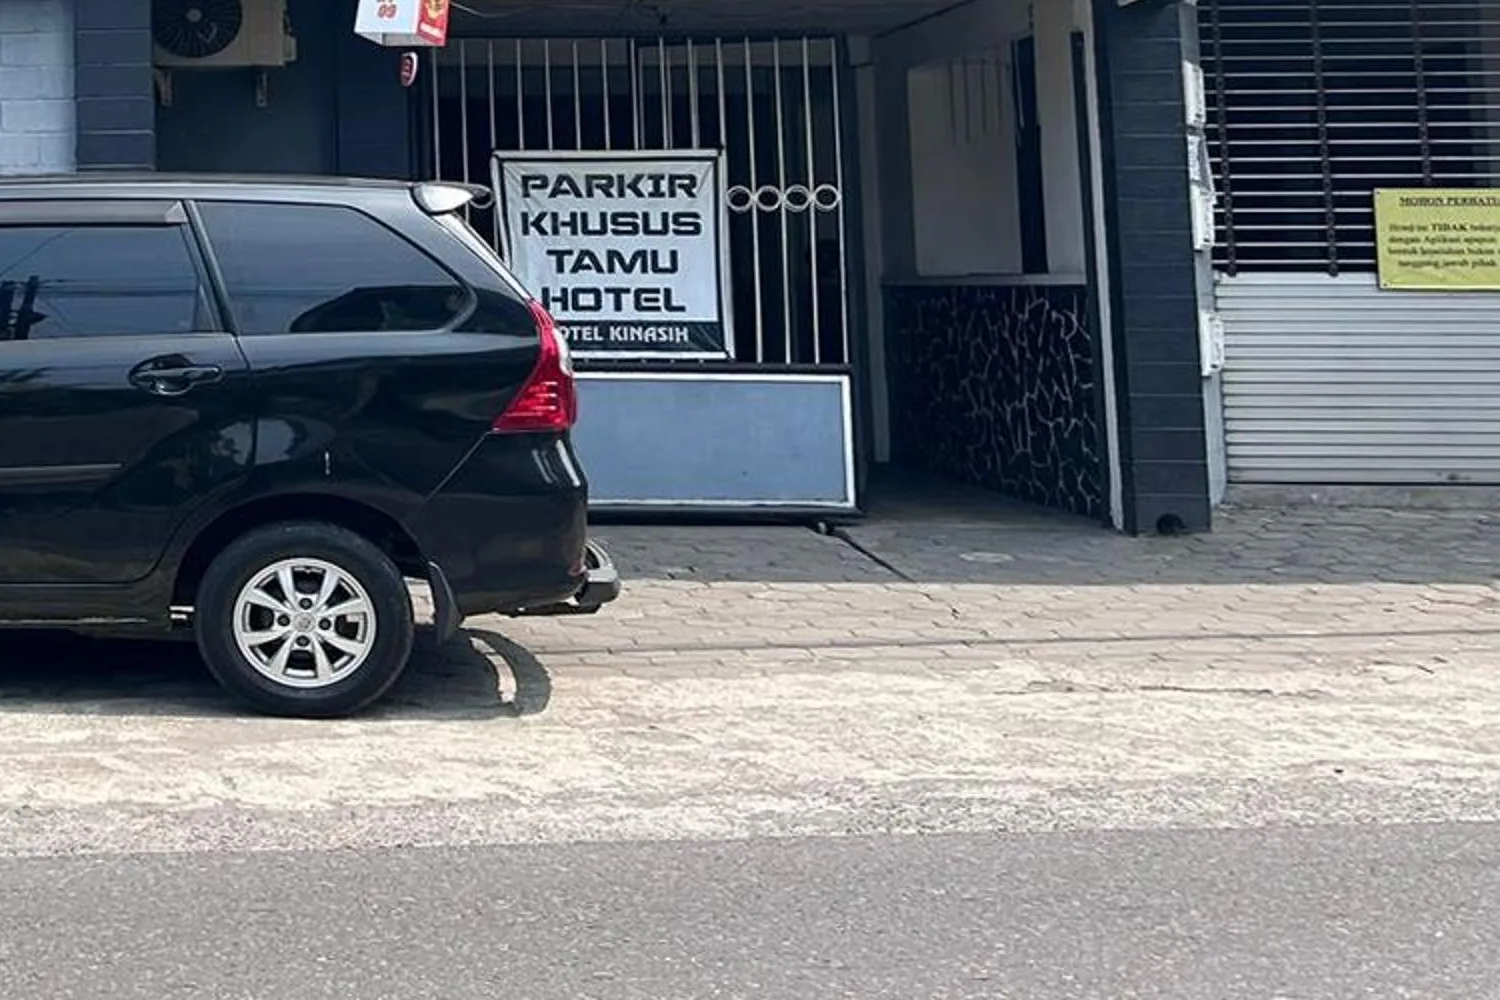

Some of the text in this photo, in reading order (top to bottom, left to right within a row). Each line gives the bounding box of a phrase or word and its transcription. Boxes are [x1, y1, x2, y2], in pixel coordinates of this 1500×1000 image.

[521, 173, 698, 199] PARKIR
[520, 211, 702, 236] KHUSUS
[546, 249, 679, 274] TAMU
[541, 287, 687, 313] HOTEL
[558, 325, 690, 343] OTEL KINASIH
